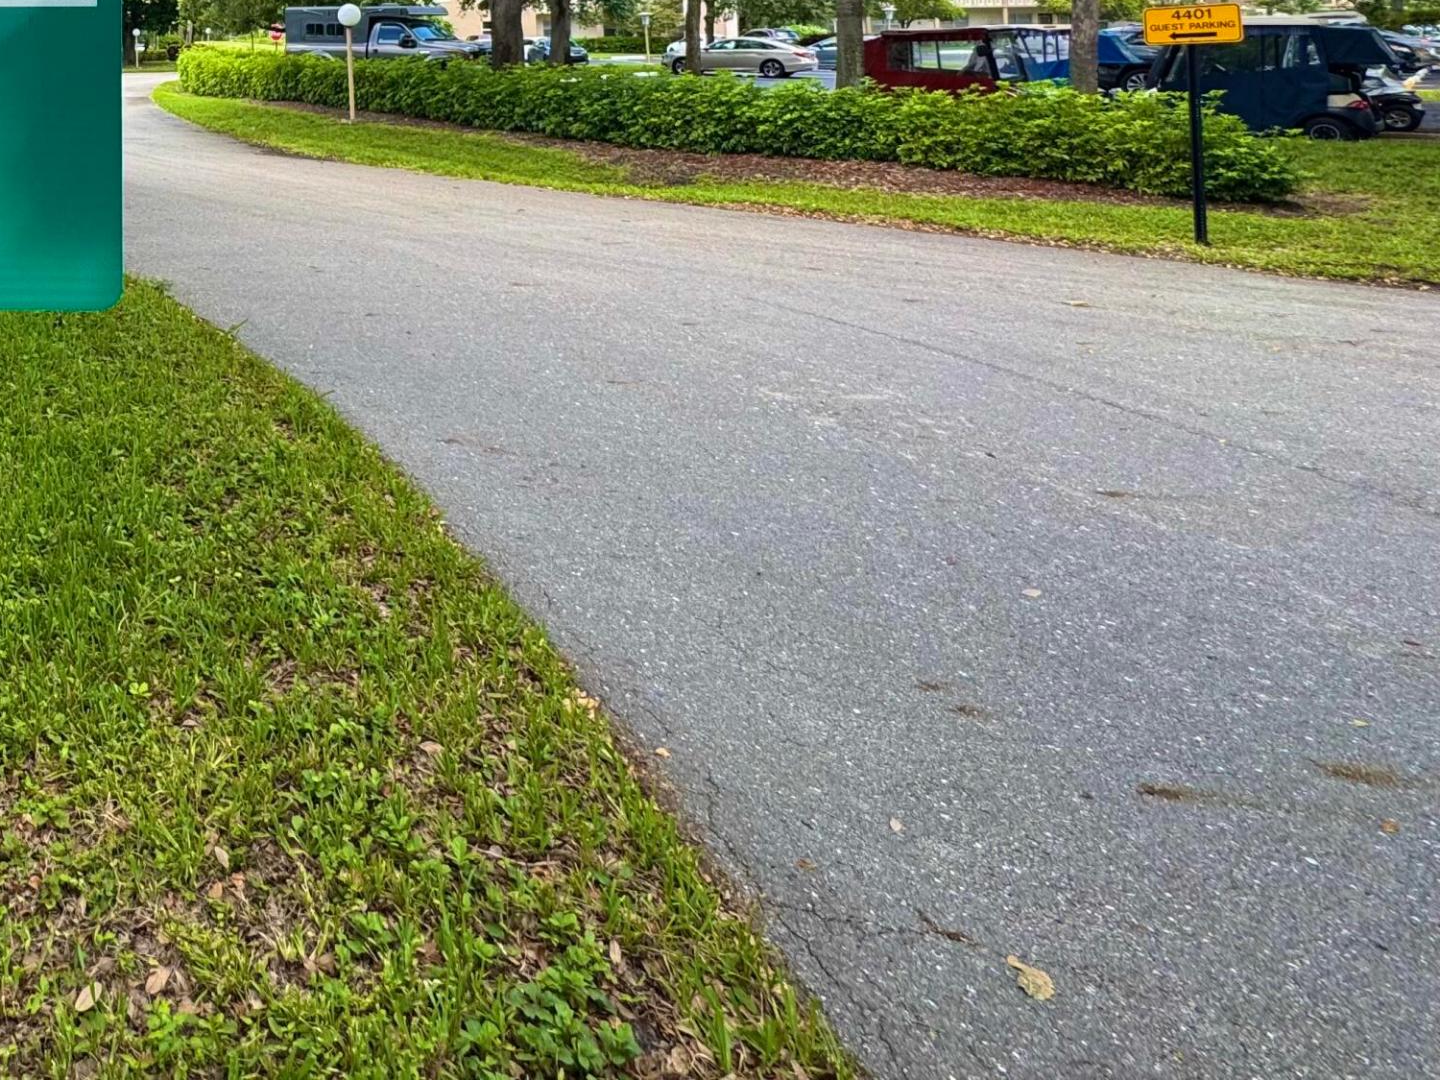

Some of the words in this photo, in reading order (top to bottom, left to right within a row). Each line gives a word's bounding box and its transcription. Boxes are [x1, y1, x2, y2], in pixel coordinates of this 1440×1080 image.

[1171, 8, 1212, 20] 4401
[1150, 23, 1184, 32] GUEST
[1189, 20, 1236, 30] PARKING
